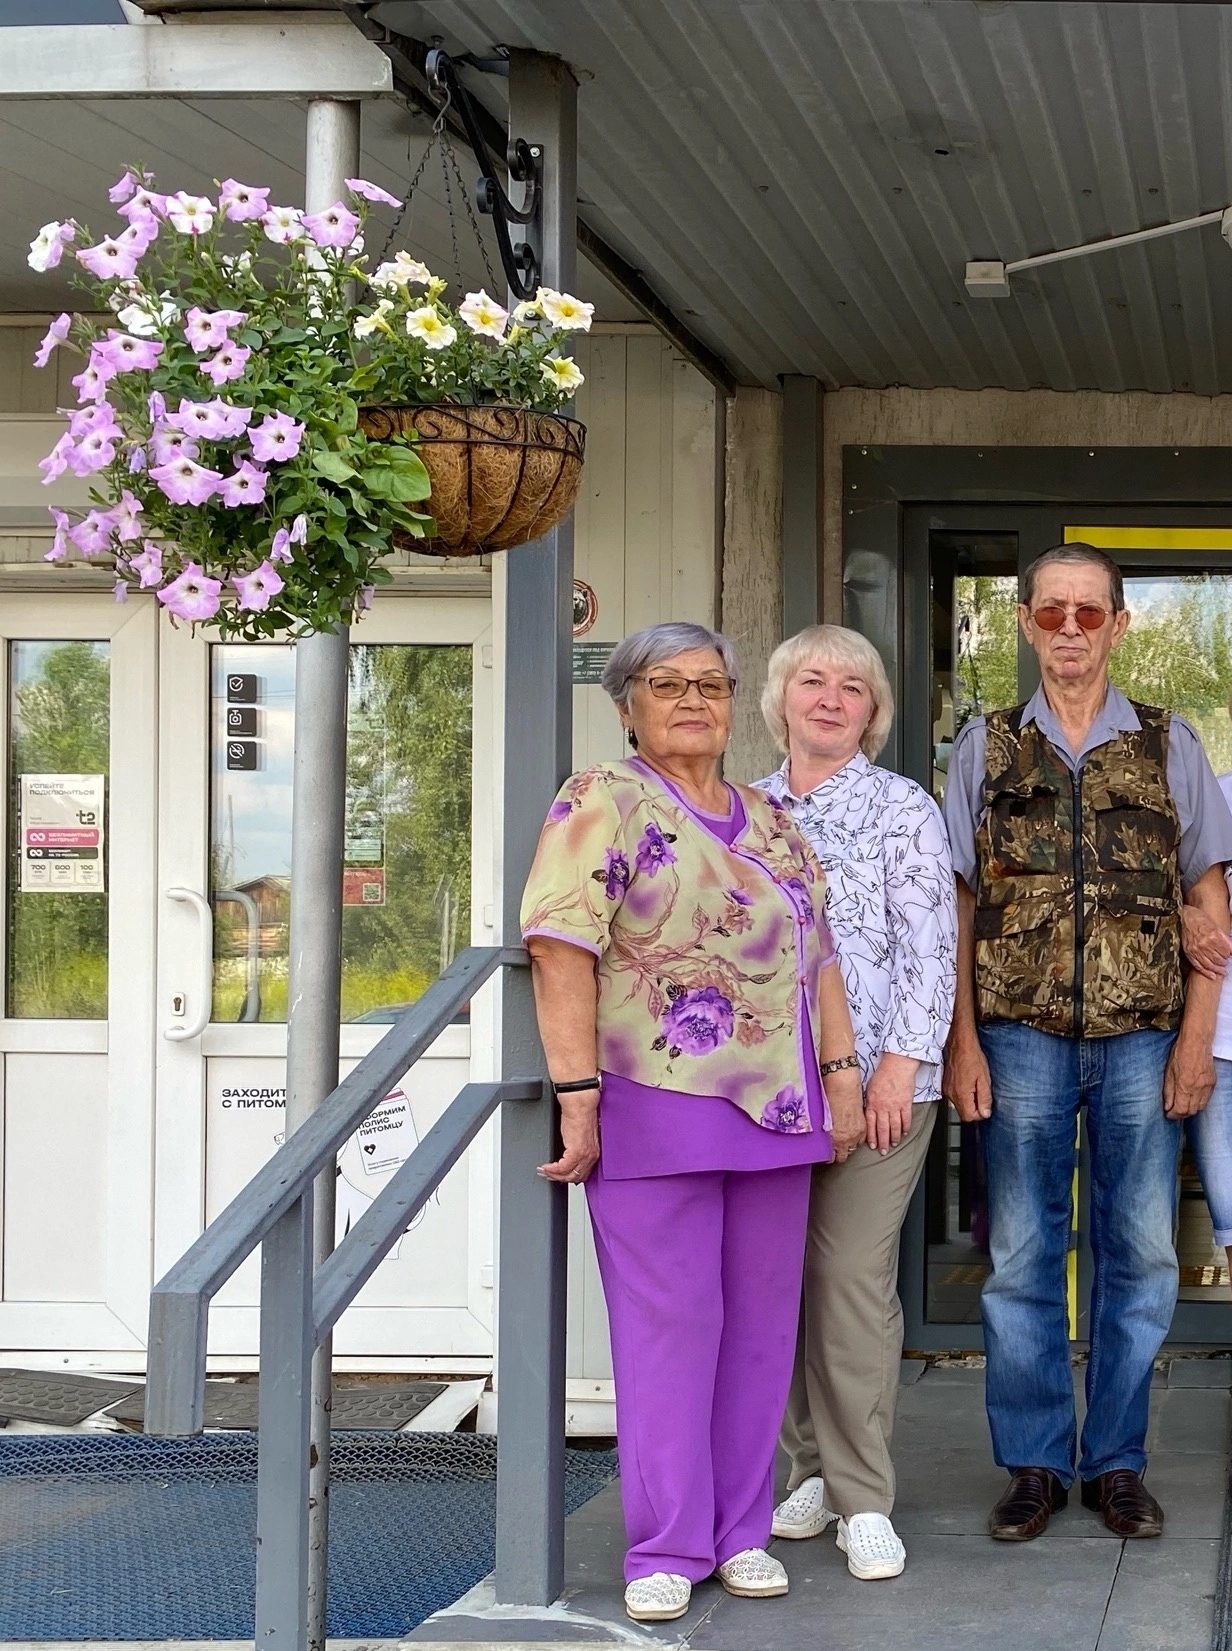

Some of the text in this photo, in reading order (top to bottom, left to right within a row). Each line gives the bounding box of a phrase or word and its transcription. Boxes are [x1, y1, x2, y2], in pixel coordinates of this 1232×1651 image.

[222, 1088, 287, 1099] ЗАХОДИТ
[222, 1099, 286, 1108] С ПИТОМ
[360, 1121, 404, 1137] ПИТОМЦУ
